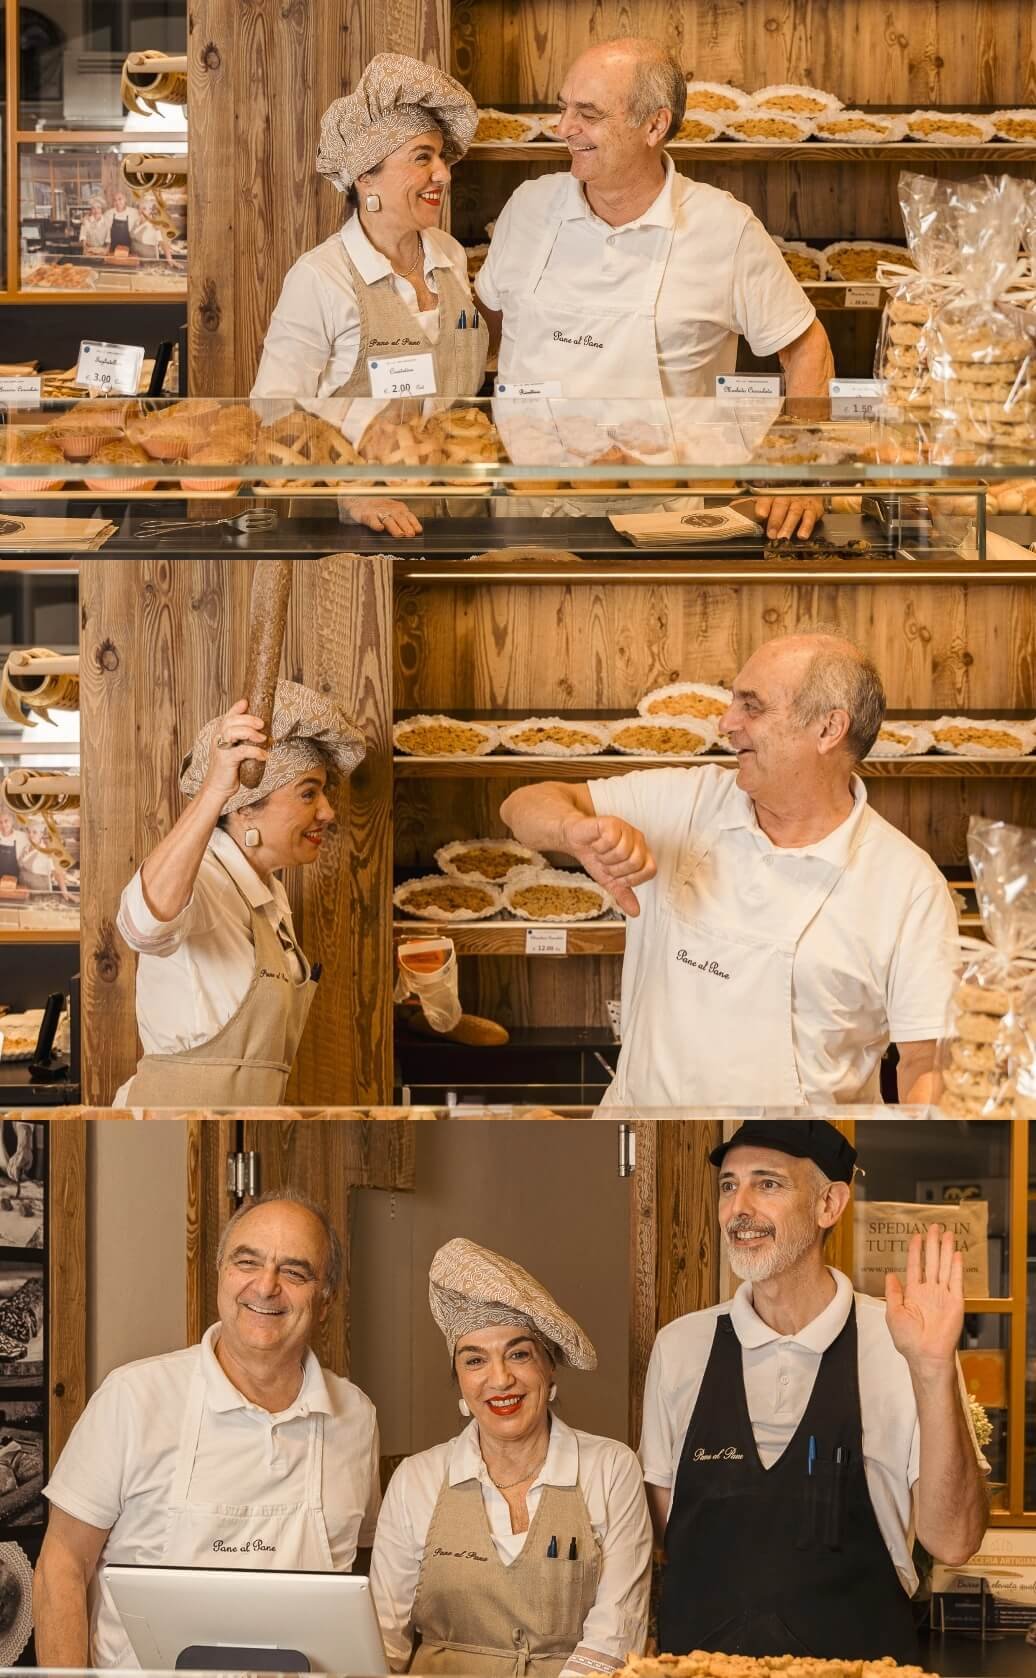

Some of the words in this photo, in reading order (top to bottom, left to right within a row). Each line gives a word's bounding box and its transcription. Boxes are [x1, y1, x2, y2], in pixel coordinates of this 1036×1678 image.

[368, 338, 389, 347] Pane
[401, 337, 420, 346] Pane
[553, 330, 573, 344] Pane
[573, 336, 581, 345] al
[583, 335, 604, 349] Pane
[94, 372, 111, 383] 3.00
[391, 383, 411, 393] 2.00
[676, 949, 697, 967] Pane
[697, 960, 709, 971] al
[708, 961, 730, 980] Pane
[954, 1222, 971, 1234] IN
[866, 1239, 909, 1253] TUTT
[692, 1448, 712, 1461] Pane
[723, 1446, 744, 1460] Pane
[212, 1539, 238, 1552] Pane
[240, 1541, 250, 1552] al
[252, 1539, 277, 1552] Pane
[432, 1547, 452, 1557] Pane
[465, 1551, 488, 1562] Pane
